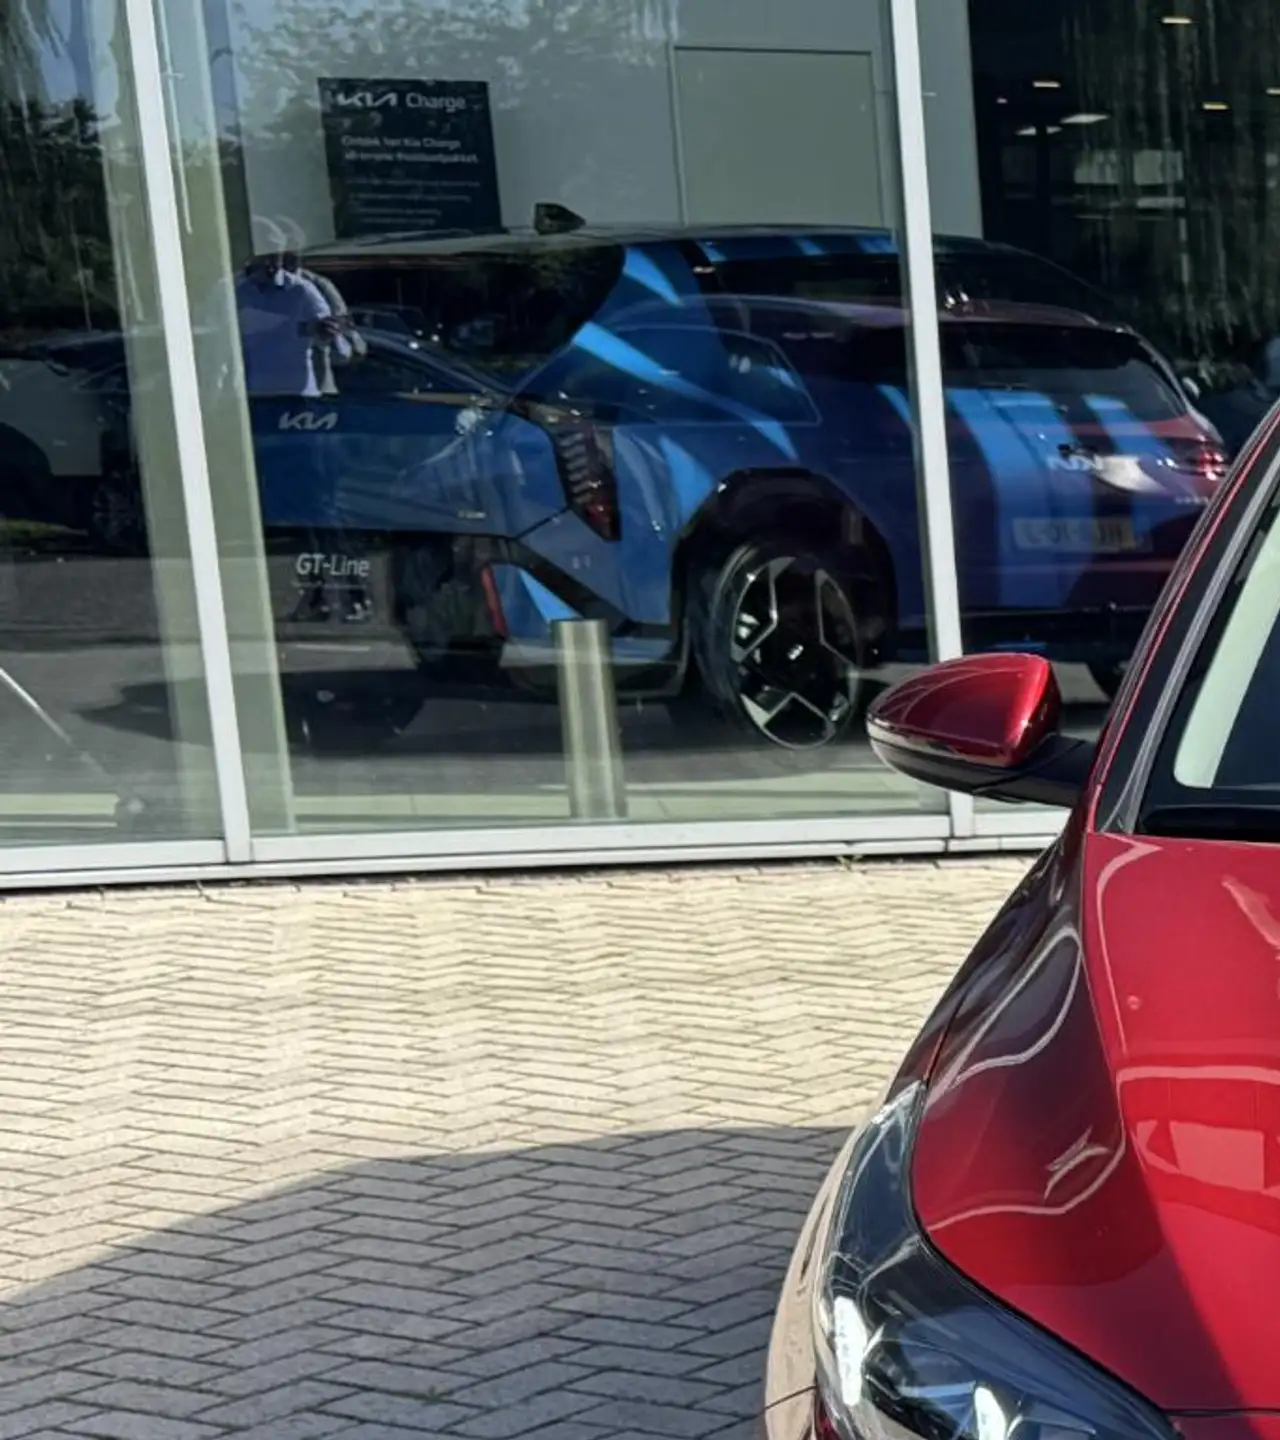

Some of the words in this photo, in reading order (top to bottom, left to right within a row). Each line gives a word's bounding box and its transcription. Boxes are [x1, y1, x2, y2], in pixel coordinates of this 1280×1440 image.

[406, 92, 466, 113] Charge
[279, 411, 338, 430] KIA
[296, 552, 370, 577] GT-Line
